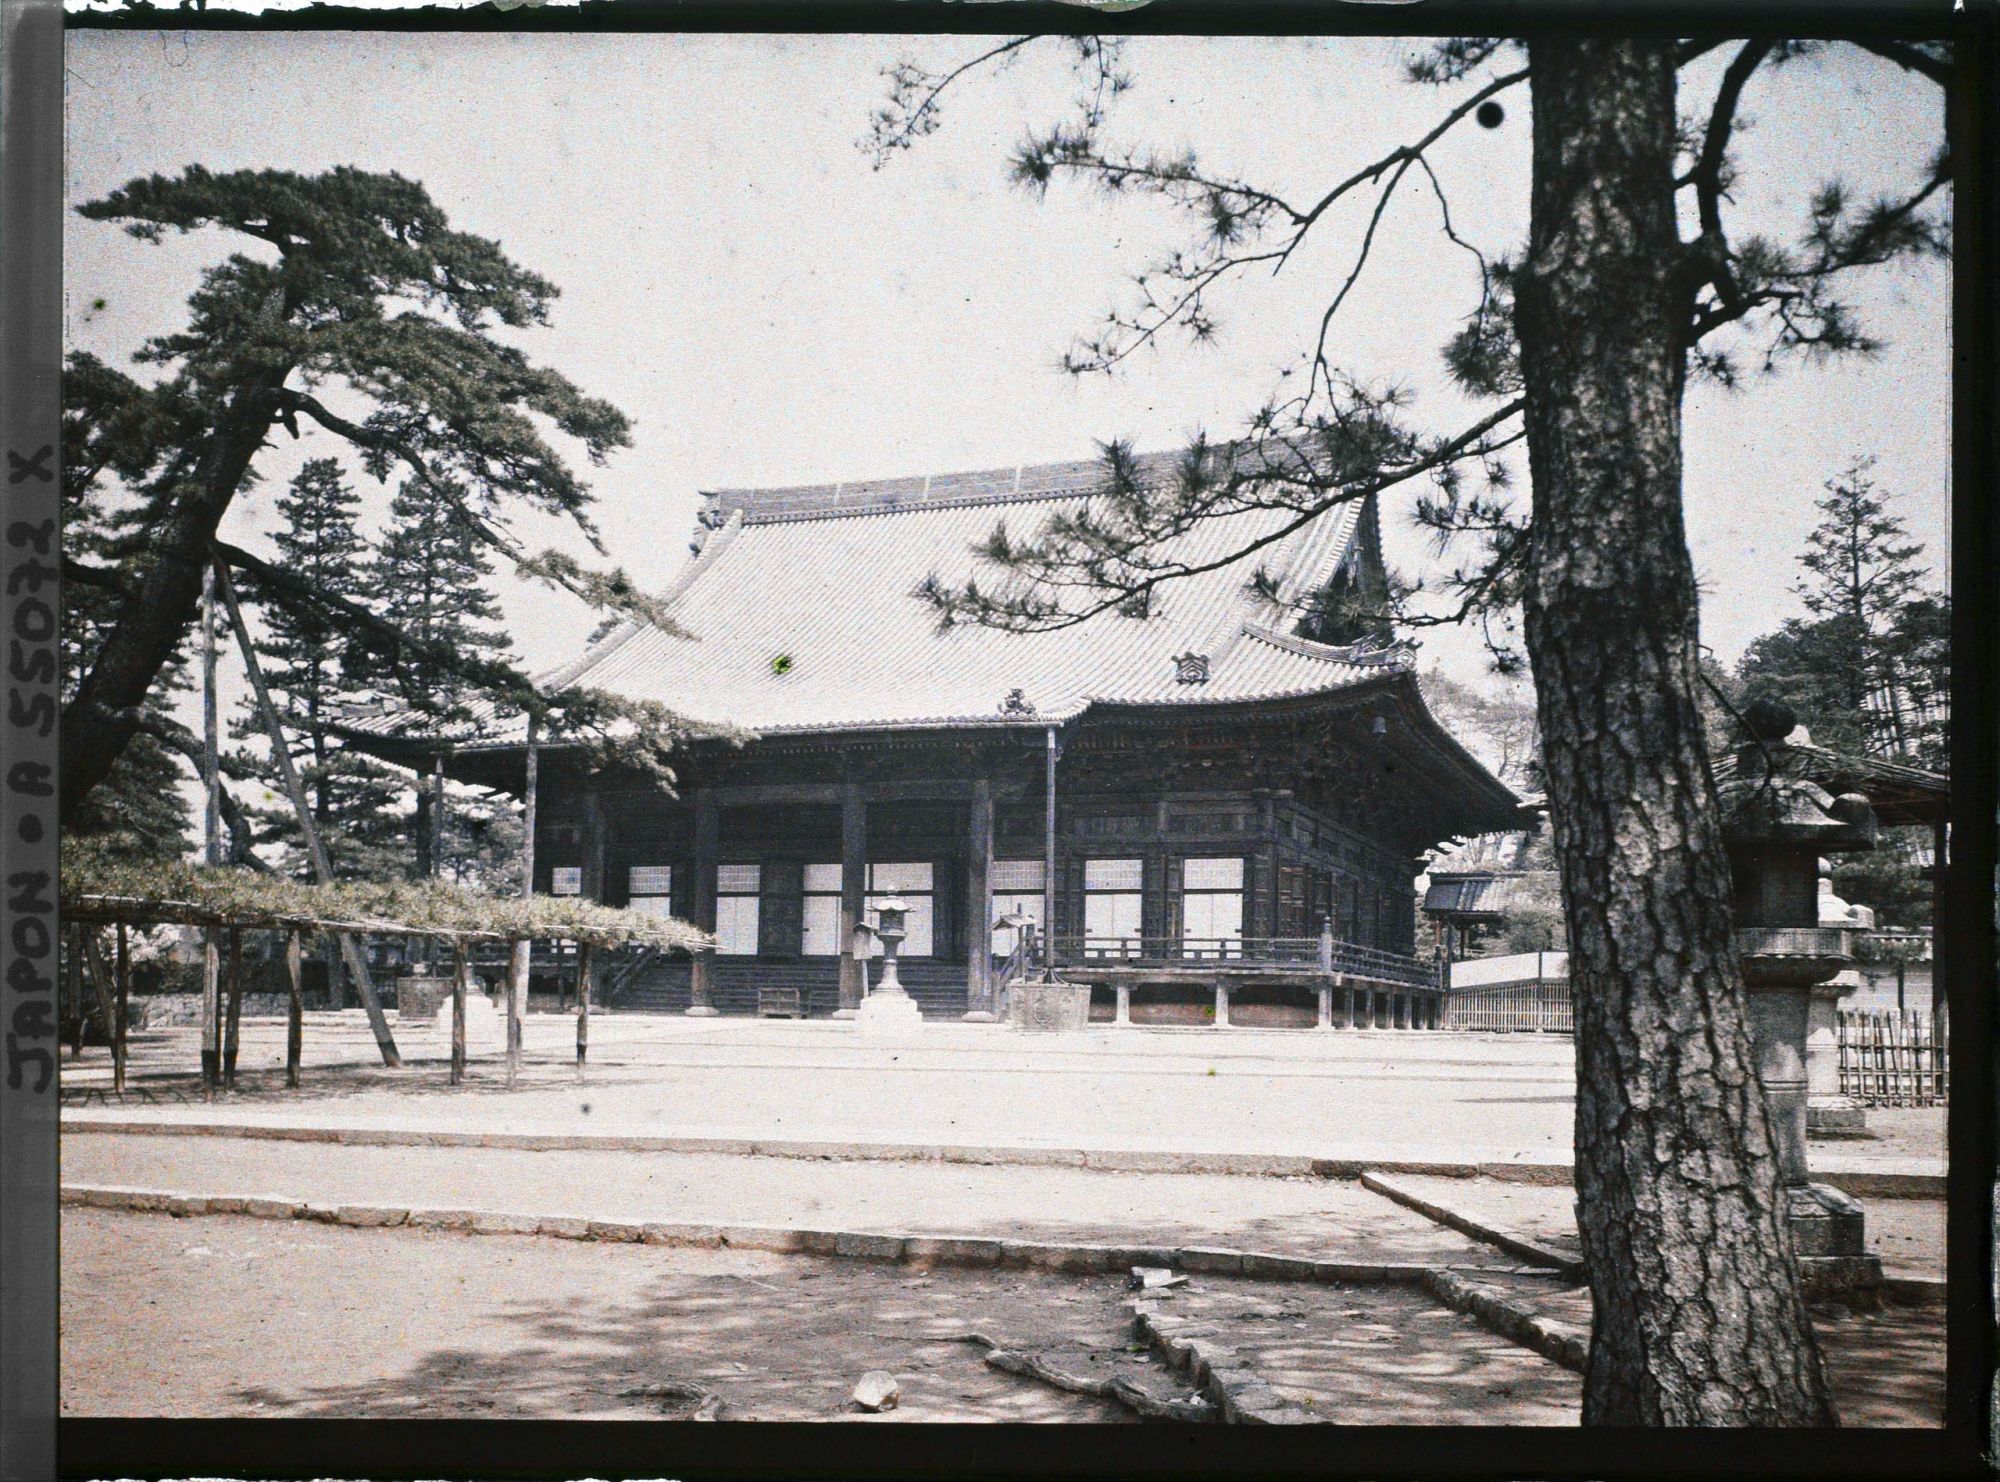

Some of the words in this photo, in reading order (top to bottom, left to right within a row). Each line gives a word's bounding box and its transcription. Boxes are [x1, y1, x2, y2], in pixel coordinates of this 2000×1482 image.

[8, 444, 54, 485] X
[8, 518, 57, 738] 55072
[8, 760, 53, 798] A
[7, 869, 53, 1093] JAPON
